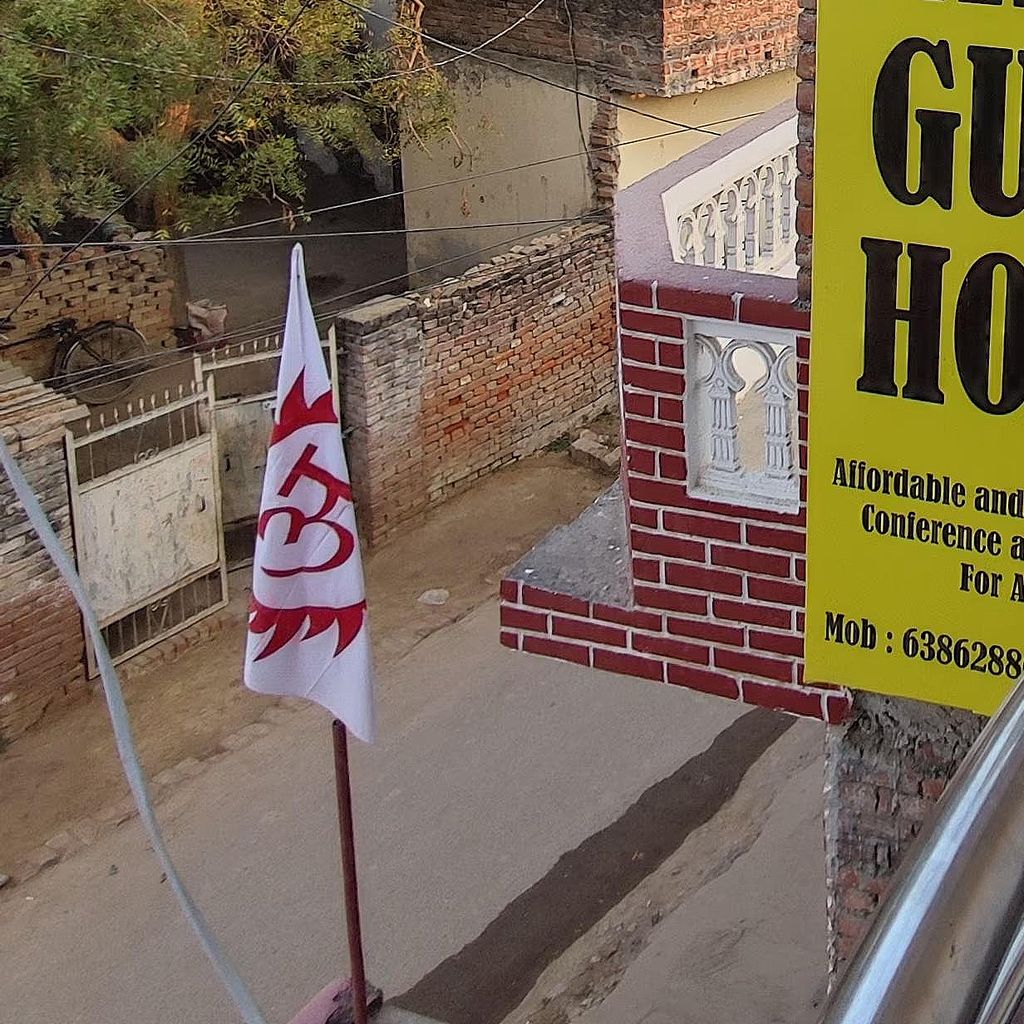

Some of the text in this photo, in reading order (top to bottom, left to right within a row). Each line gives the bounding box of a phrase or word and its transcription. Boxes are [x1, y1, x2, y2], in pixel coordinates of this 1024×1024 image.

[831, 457, 966, 508] Affordable
[974, 485, 1024, 519] and
[861, 503, 1002, 557] Conference
[959, 562, 1003, 597] For
[824, 610, 877, 650] Mob
